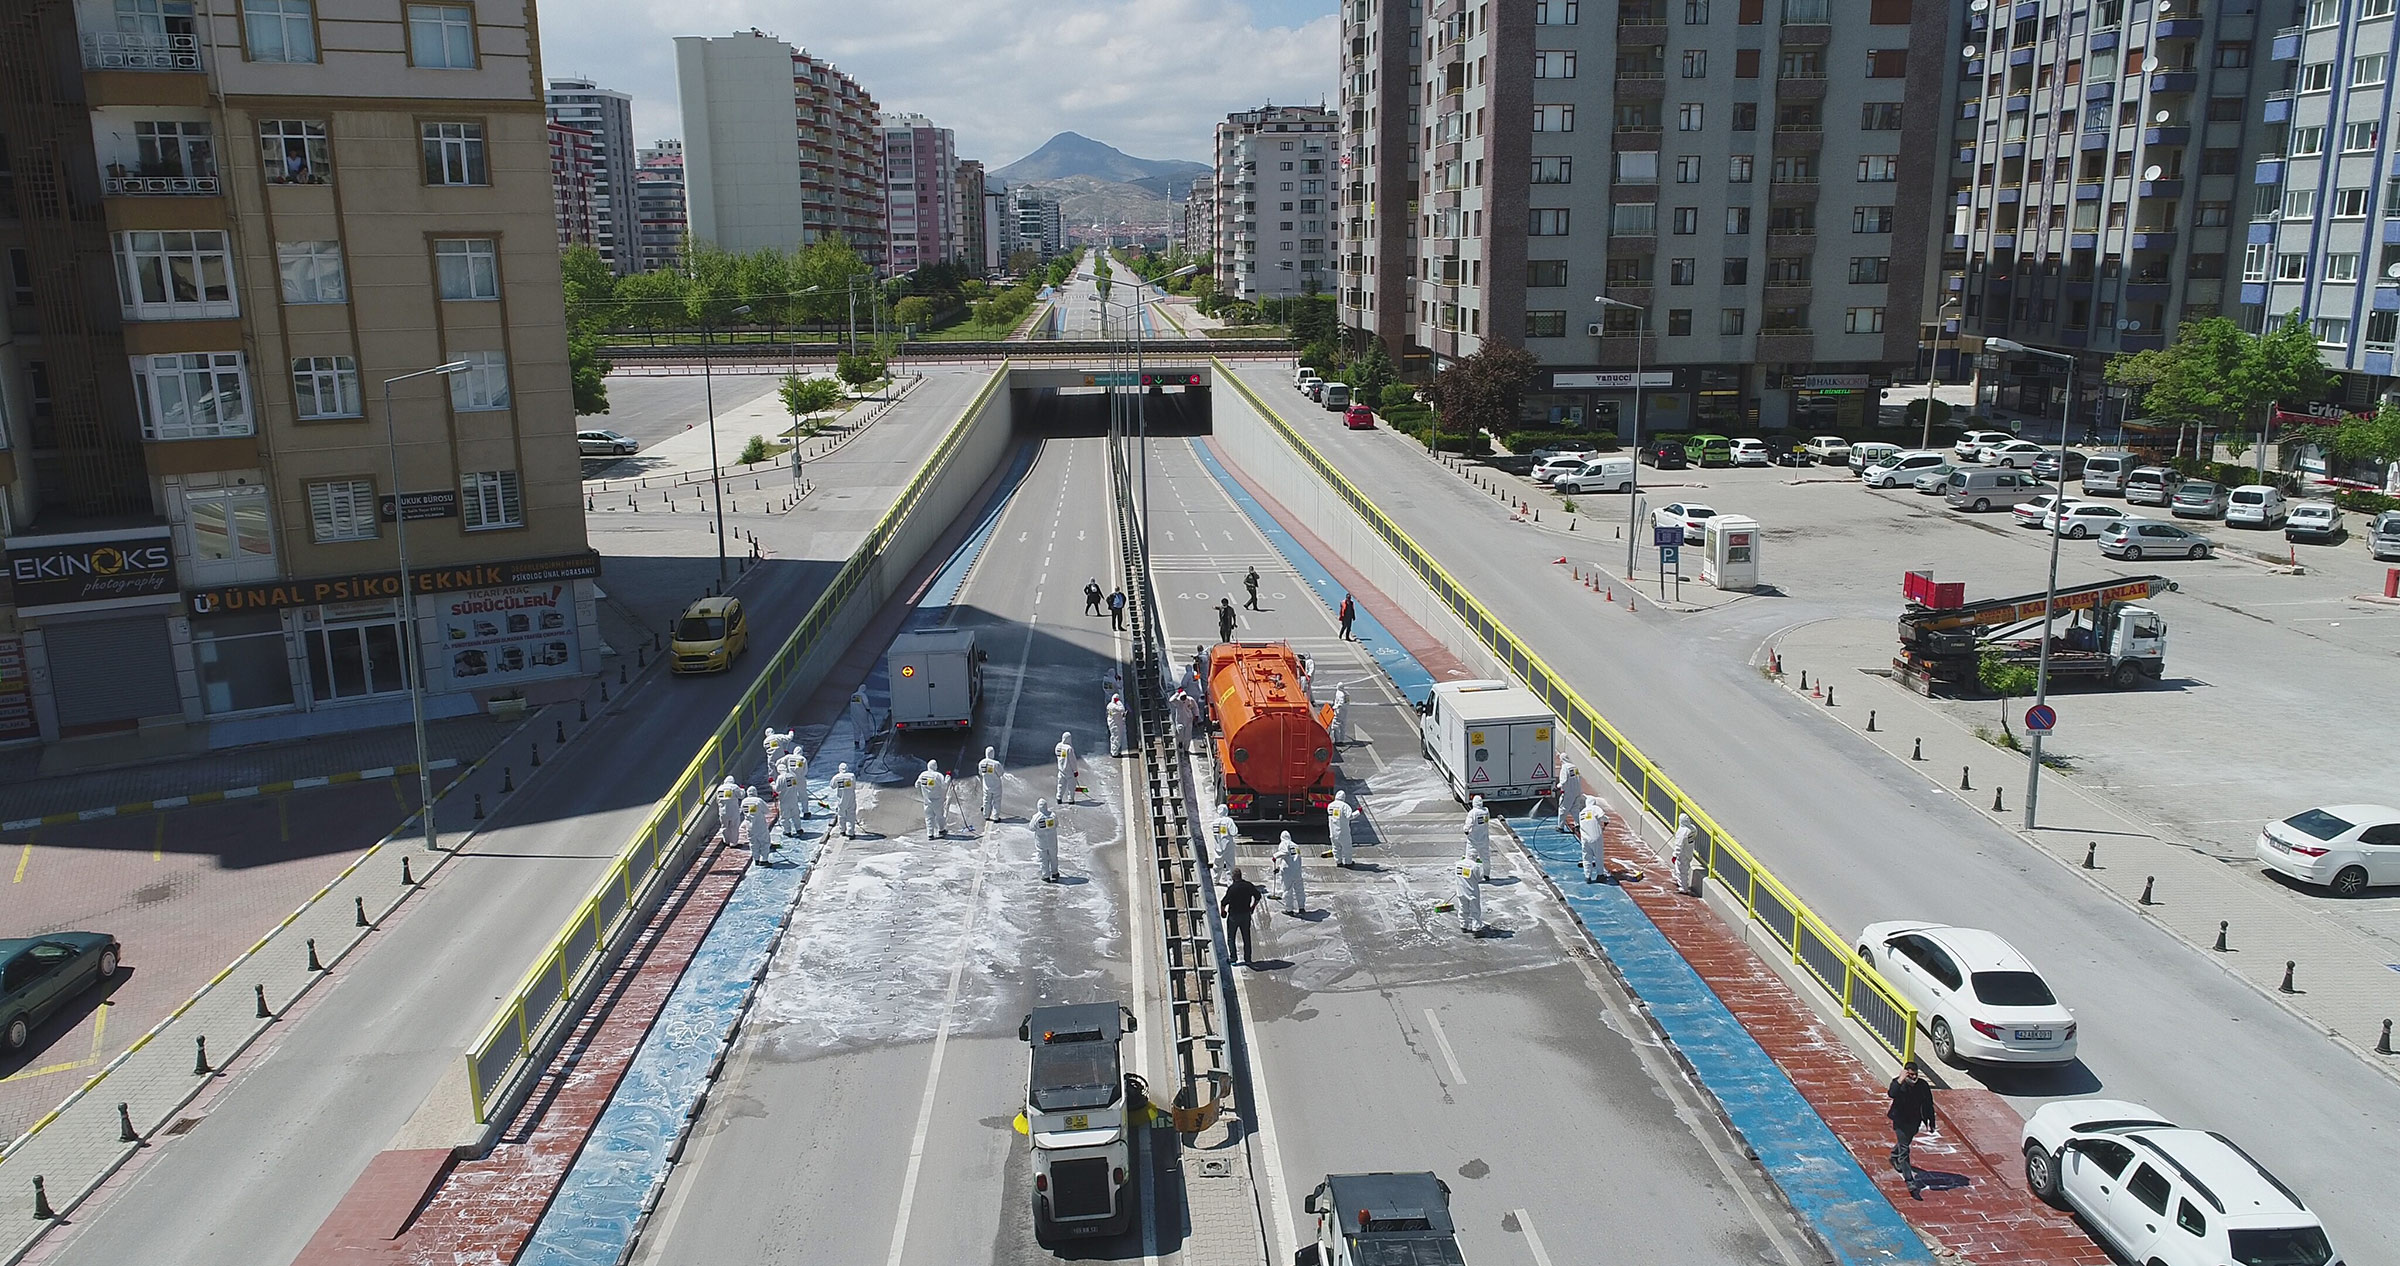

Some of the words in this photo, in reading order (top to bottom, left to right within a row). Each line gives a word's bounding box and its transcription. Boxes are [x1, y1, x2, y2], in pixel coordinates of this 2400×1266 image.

[1596, 374, 1632, 382] vanucci
[399, 497, 422, 505] UKUK
[423, 494, 454, 504] BÜROSU
[14, 547, 169, 580] EKİNOKS
[82, 573, 166, 597] photography
[226, 586, 305, 609] ÜNAL
[314, 565, 503, 601] PSİKOEKNİK
